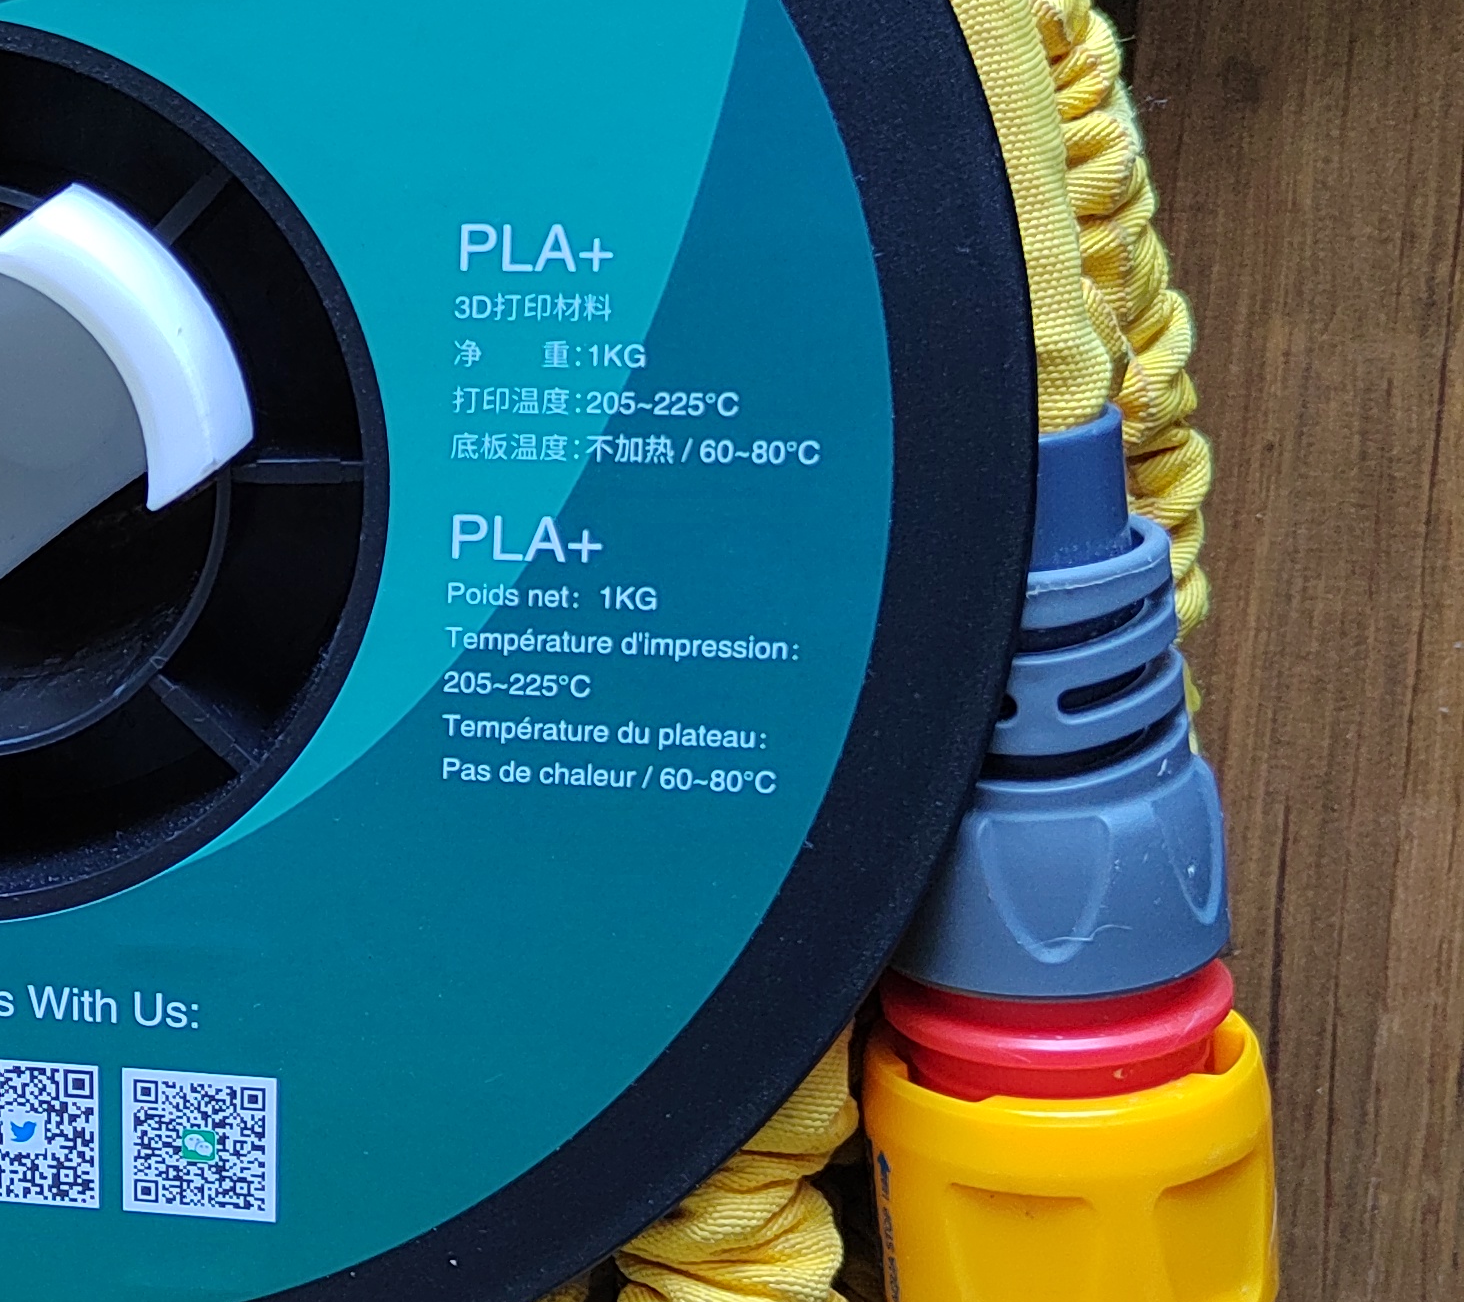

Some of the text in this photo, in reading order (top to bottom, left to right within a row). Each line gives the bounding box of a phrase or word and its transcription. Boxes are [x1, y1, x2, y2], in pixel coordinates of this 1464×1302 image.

[459, 223, 614, 273] PLA+
[680, 438, 694, 464] /
[451, 513, 603, 564] PLA+
[446, 582, 658, 611] Poids net: 1KG
[445, 626, 800, 662] Température d'impression:
[441, 713, 768, 751] Température du plateau:
[442, 758, 491, 781] Pas
[499, 760, 531, 784] de
[539, 763, 636, 788] chaleur
[641, 766, 653, 789] /
[27, 984, 119, 1024] With
[134, 991, 200, 1030] Us:
